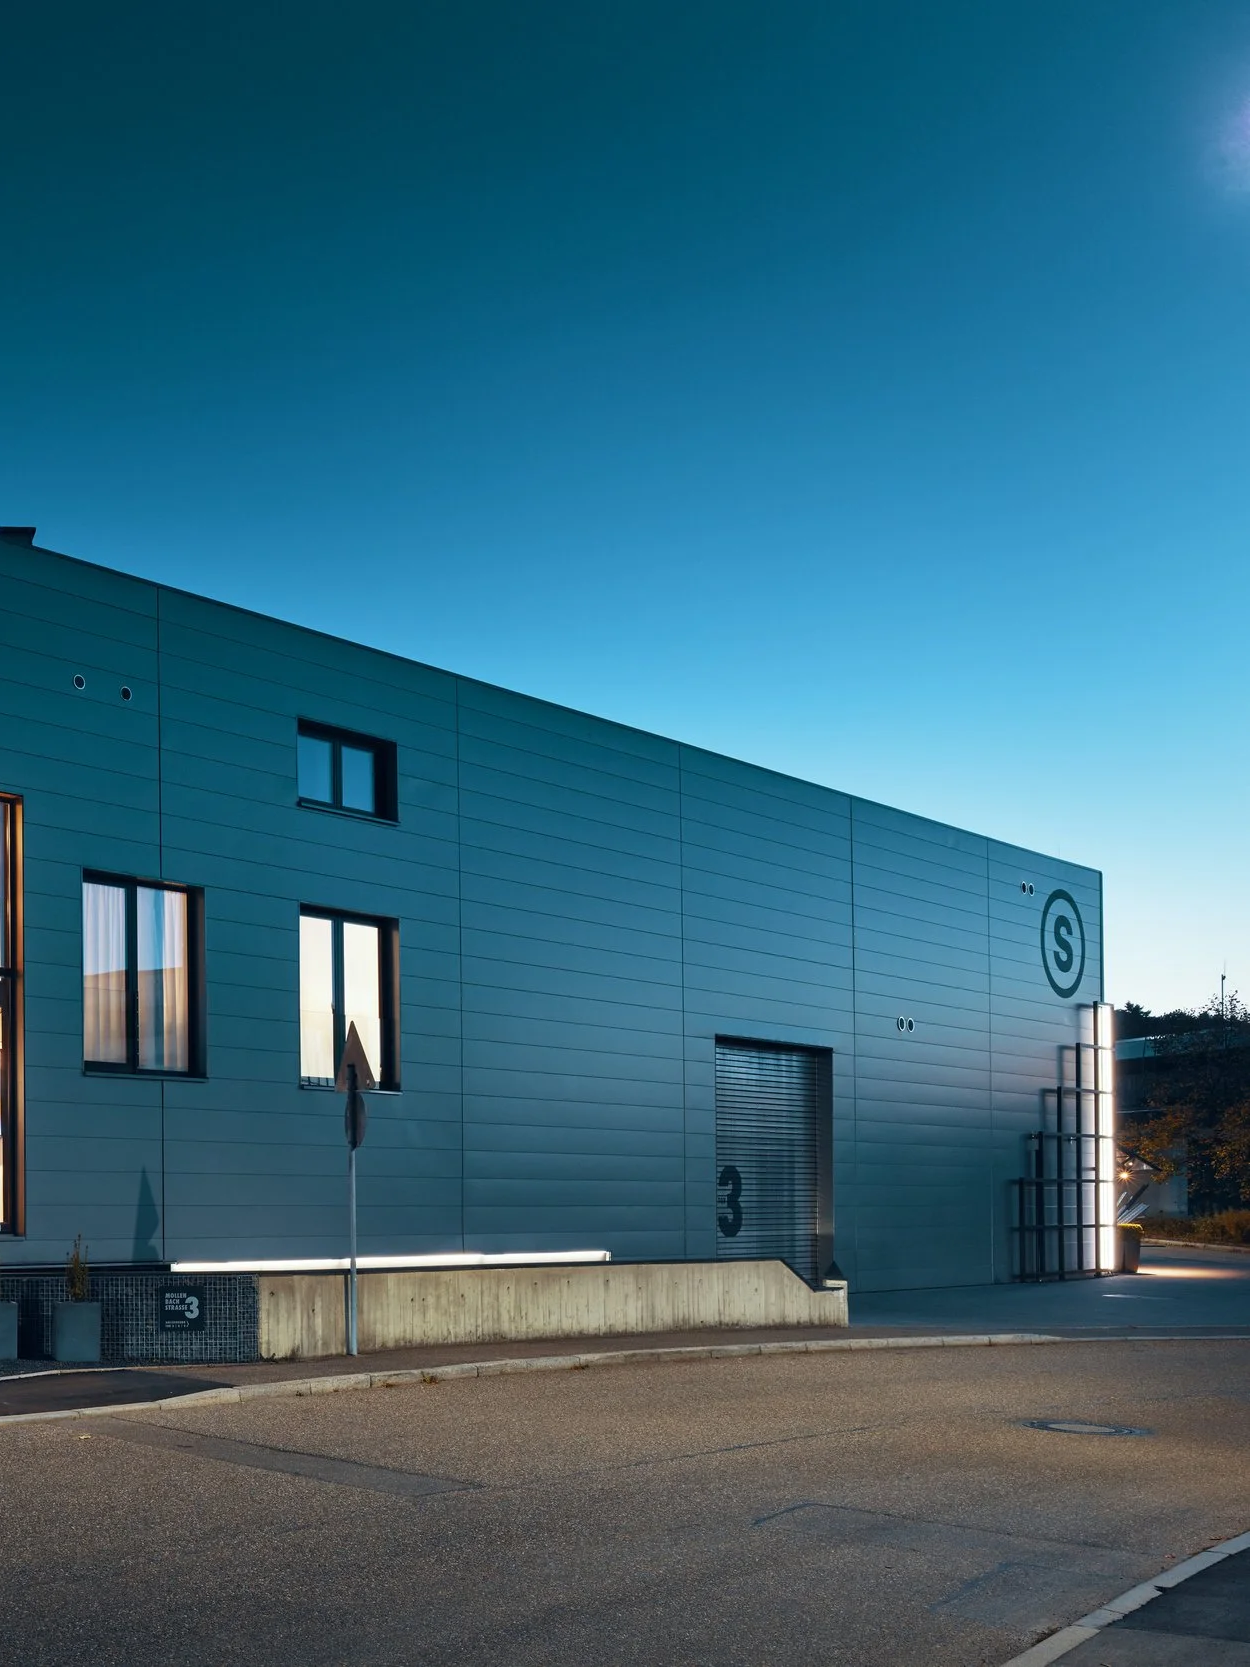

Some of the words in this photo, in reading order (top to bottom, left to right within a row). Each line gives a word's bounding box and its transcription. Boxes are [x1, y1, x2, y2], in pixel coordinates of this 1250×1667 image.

[1053, 914, 1074, 973] S
[717, 1165, 743, 1238] 3
[184, 1296, 199, 1318] 3
